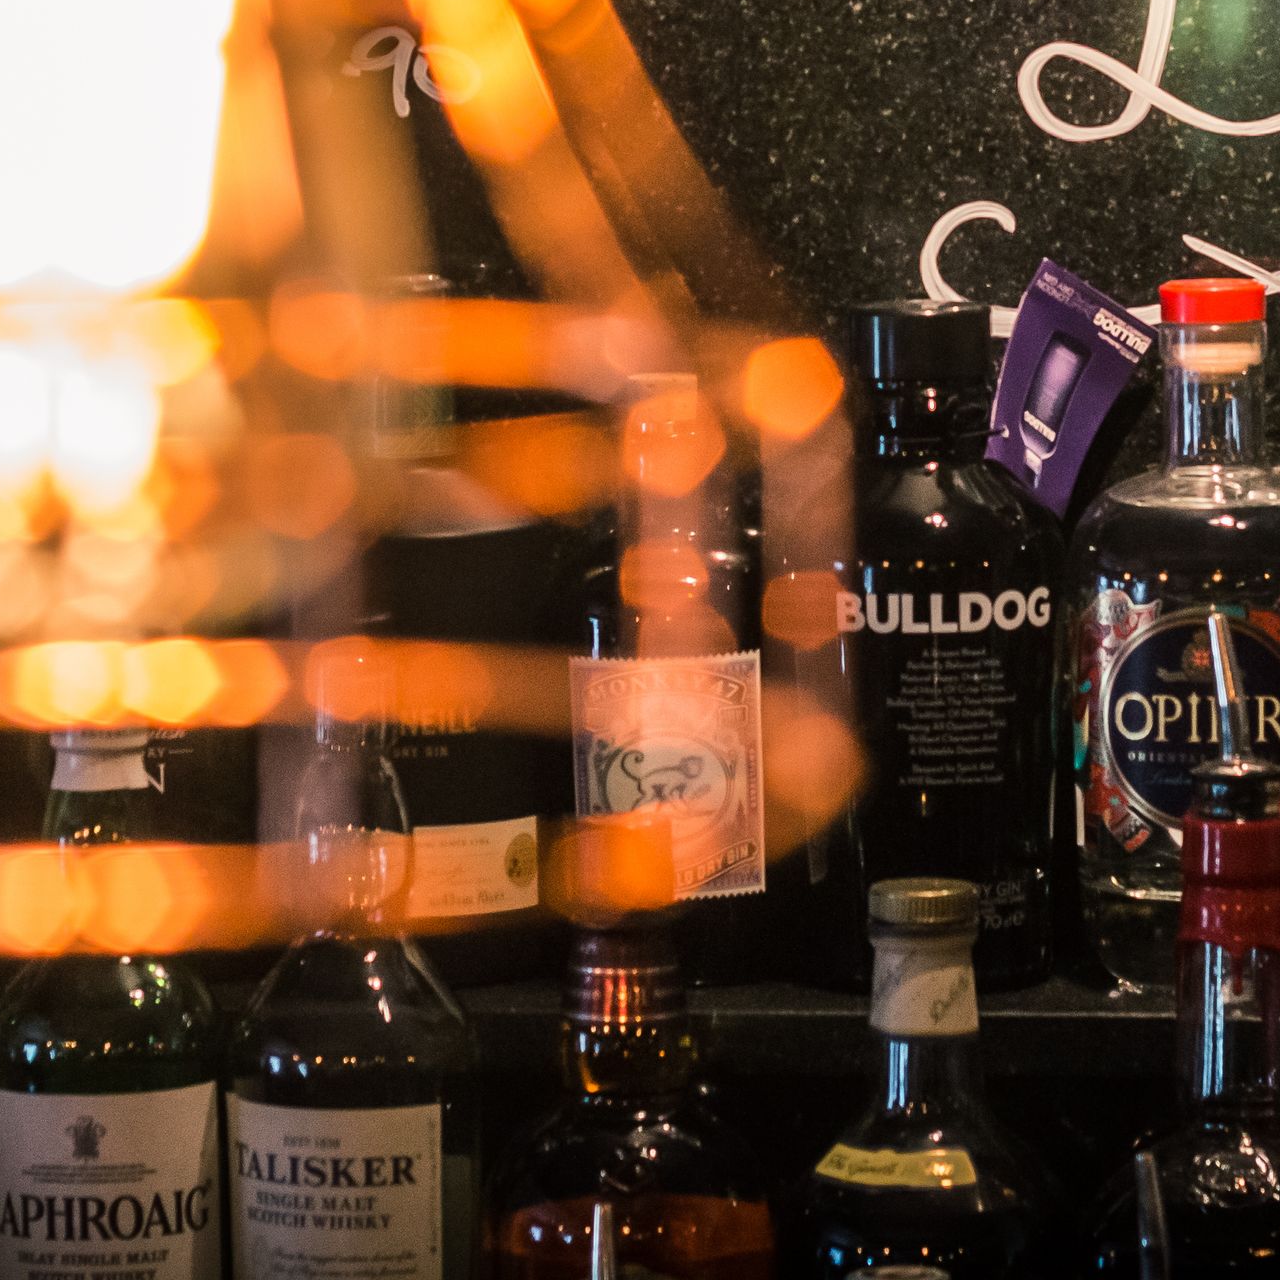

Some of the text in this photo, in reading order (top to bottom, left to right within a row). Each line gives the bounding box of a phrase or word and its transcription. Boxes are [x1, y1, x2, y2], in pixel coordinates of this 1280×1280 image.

[836, 586, 1050, 634] BULLDOG
[235, 1140, 417, 1189] TALISKER
[321, 1197, 376, 1212] MALT
